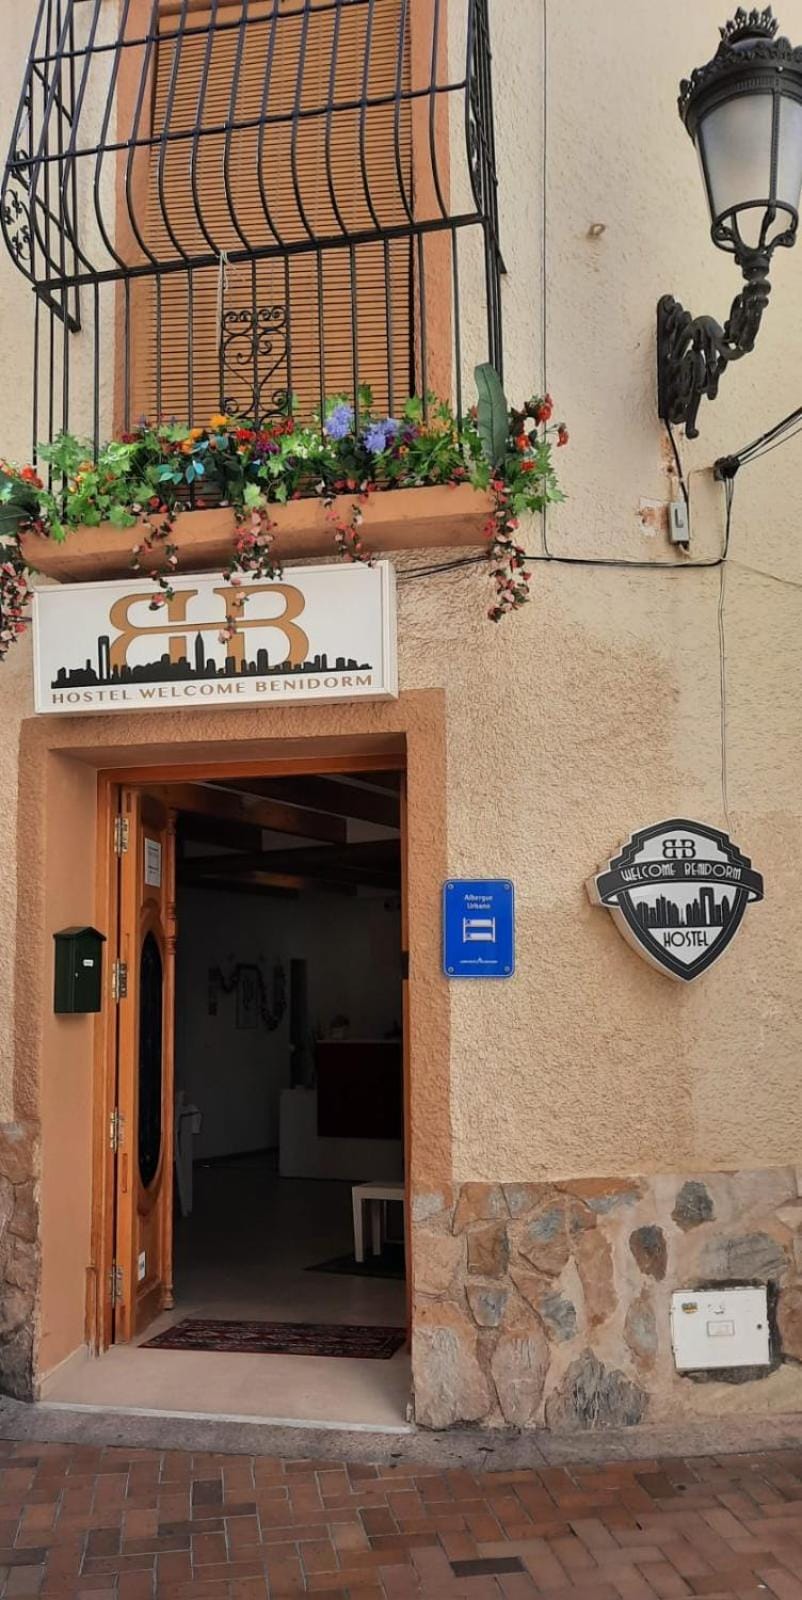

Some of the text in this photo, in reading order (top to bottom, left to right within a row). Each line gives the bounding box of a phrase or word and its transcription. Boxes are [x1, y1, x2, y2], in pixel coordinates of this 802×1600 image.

[52, 674, 373, 705] HOSTEL WELCOME BENIDORM
[620, 862, 742, 882] WELCOME BENIDORM
[464, 894, 493, 902] Albergue
[466, 902, 491, 910] Urbano
[663, 931, 709, 947] HOSTEL
